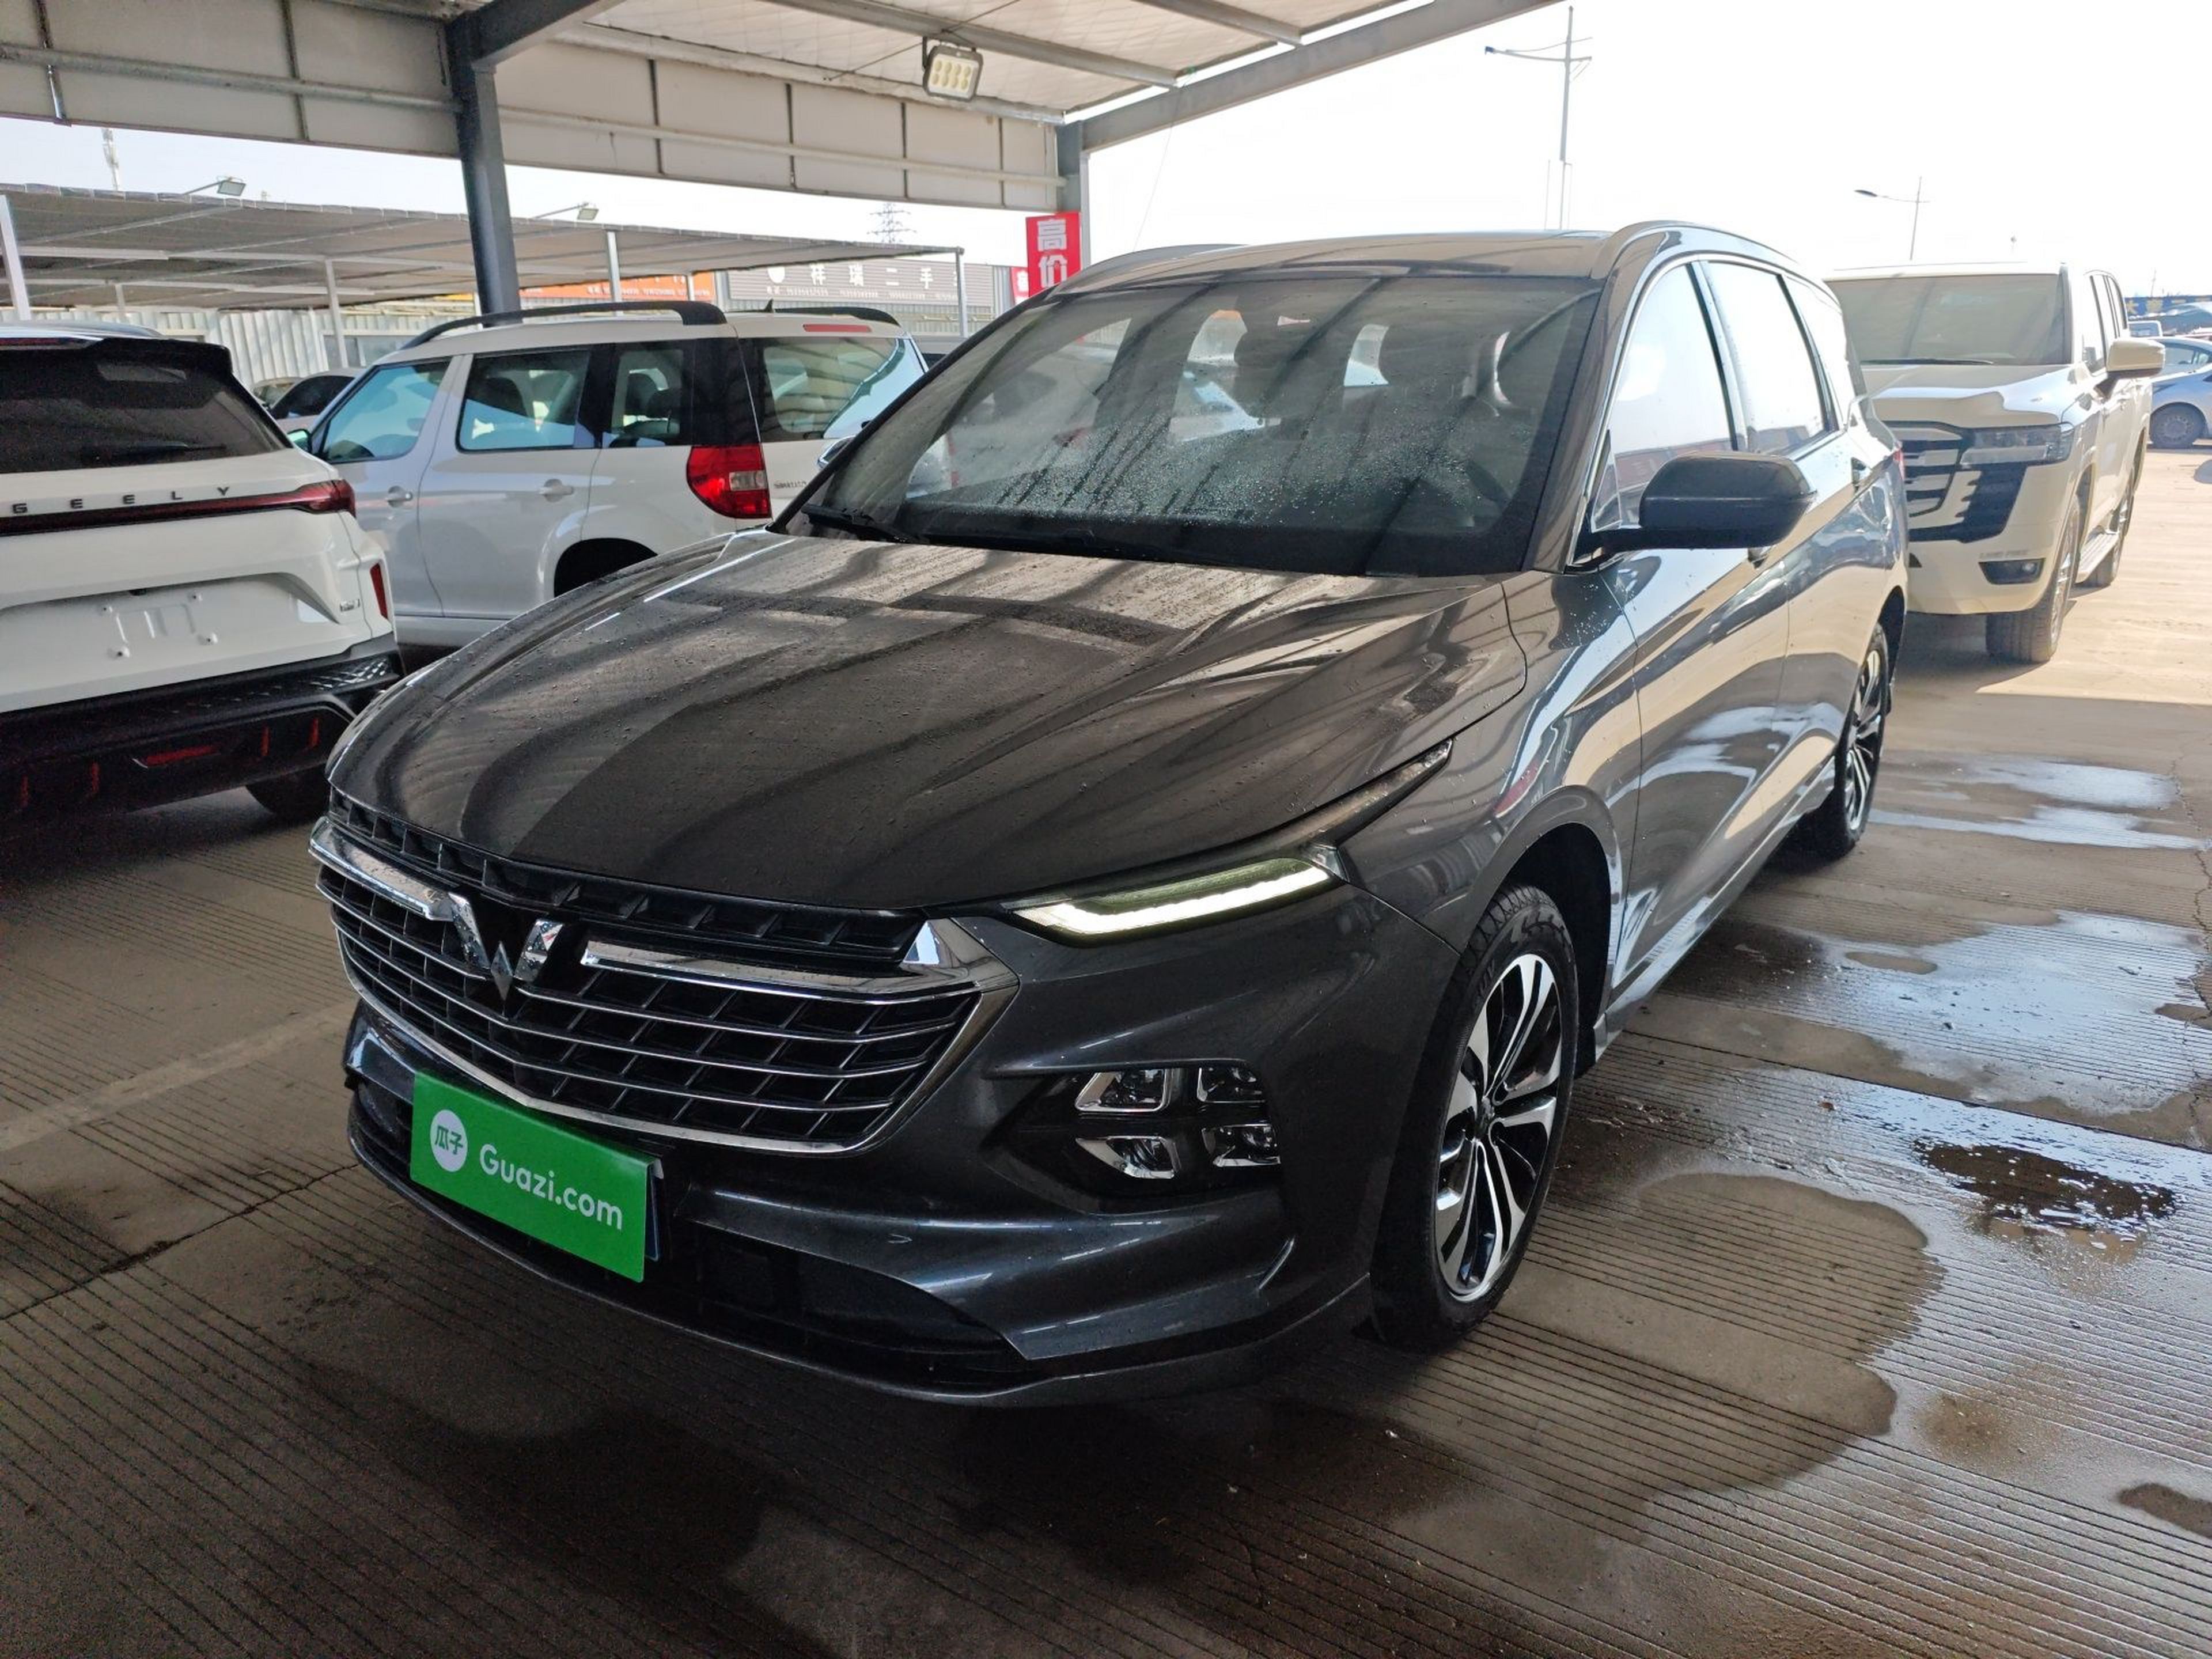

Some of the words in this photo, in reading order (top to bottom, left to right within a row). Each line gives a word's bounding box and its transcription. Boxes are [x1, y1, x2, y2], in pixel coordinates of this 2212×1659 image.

[1037, 219, 1067, 288] 高价
[809, 262, 957, 289] 祥瑞二手
[12, 487, 230, 514] GEELY
[434, 1125, 463, 1155] 瓜子
[480, 1143, 622, 1230] Guazi.com
